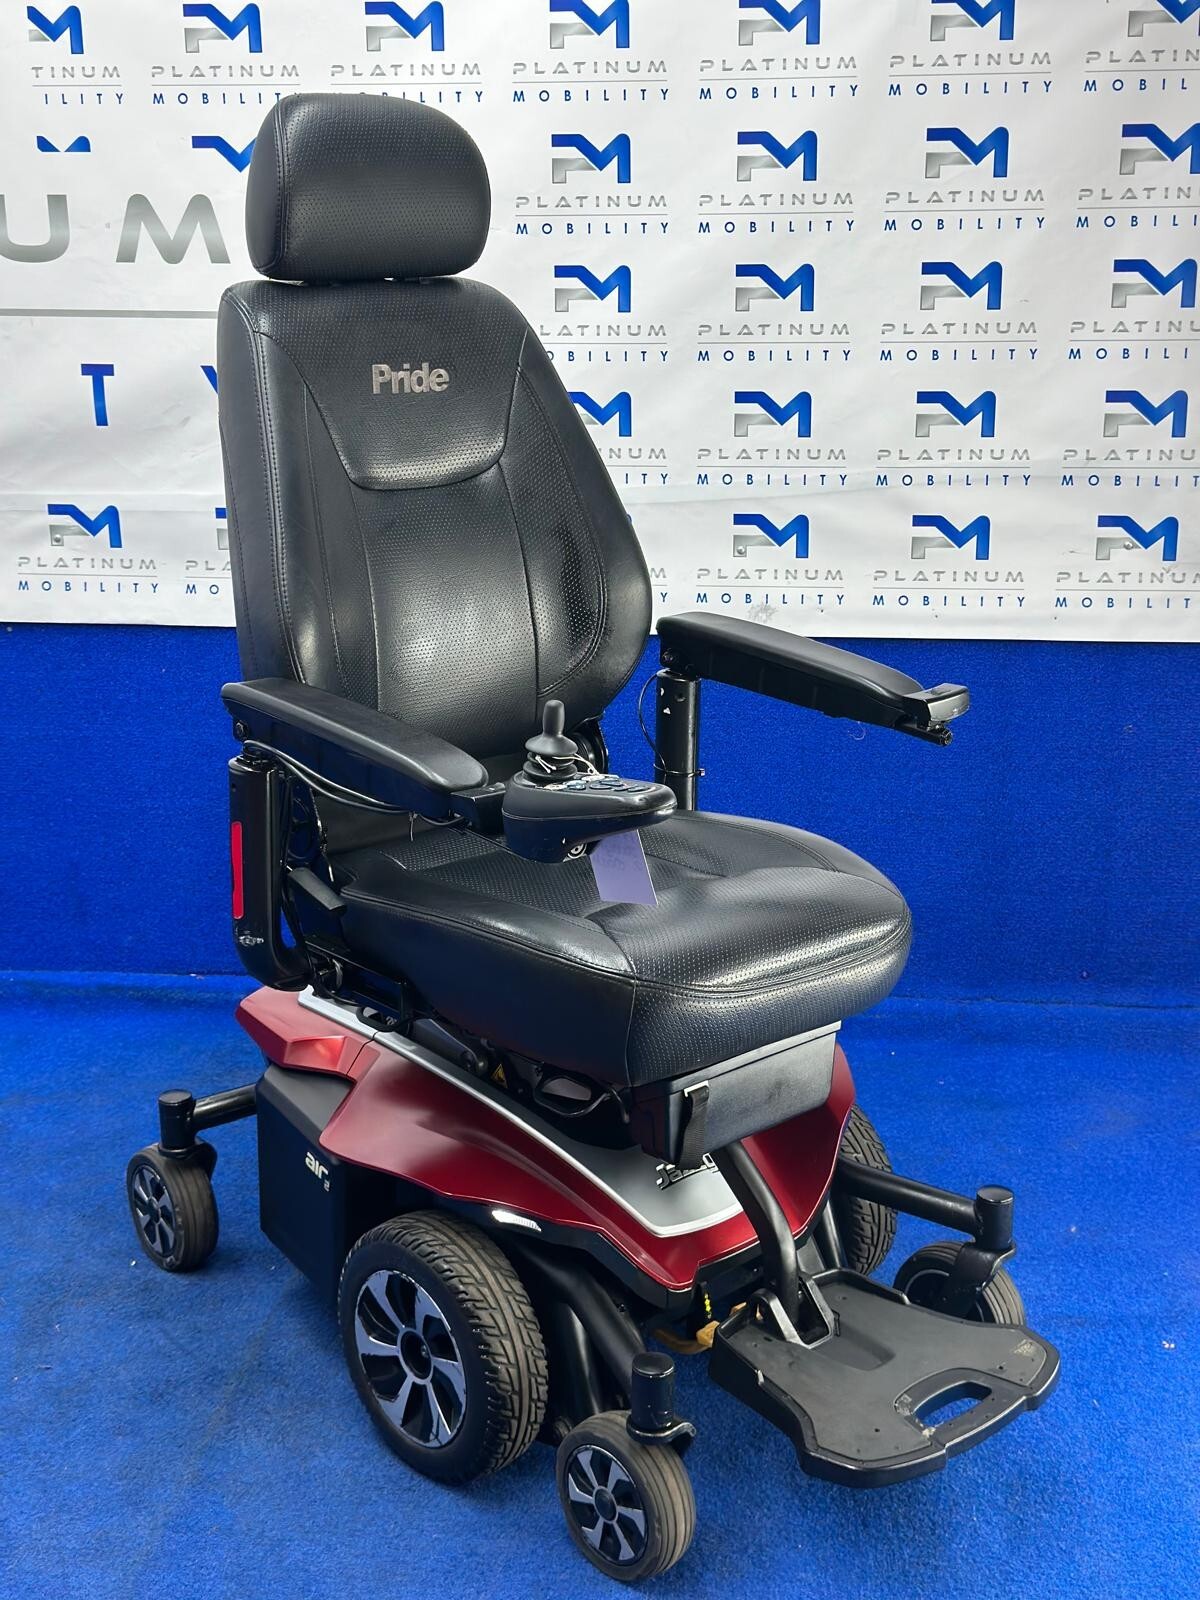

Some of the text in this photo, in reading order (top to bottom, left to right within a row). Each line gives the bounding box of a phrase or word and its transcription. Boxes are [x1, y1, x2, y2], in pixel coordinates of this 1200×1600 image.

[700, 56, 856, 72] PLATINUM
[890, 52, 1051, 68] PLATINUM
[152, 65, 299, 78] PLATINUM
[331, 63, 480, 76] PLATINUM
[513, 60, 667, 75] PLATINUM
[513, 88, 669, 102] MOBILITY
[699, 84, 858, 100] MOBILITY
[888, 81, 1052, 96] MOBILITY
[152, 92, 302, 105] MOBILIT
[516, 195, 667, 208] PLATINUM
[699, 193, 853, 206] PLATINUM
[886, 189, 1044, 204] PLATINUM
[516, 222, 668, 235] MOBILITY
[698, 220, 854, 233] MOBILITY
[884, 217, 1045, 231] MOBILITY
[698, 324, 849, 336] PLATINUM
[881, 322, 1036, 335] PLATINUM
[698, 350, 851, 361] MOBILITY
[880, 348, 1037, 361] MOBILITY
[372, 362, 450, 395] Pride
[698, 449, 846, 460] PLATINUM
[877, 449, 1030, 460] PLATINUM
[697, 474, 847, 486] MOBILITY
[876, 474, 1032, 486] MOBILITY
[18, 557, 156, 569] PLATINUM
[697, 568, 843, 580] PLATINUM
[874, 570, 1024, 582] PLATINUM
[18, 580, 158, 593] MOBILITY
[696, 593, 845, 606] MOBILITY
[873, 595, 1025, 607] MOBILITY
[305, 1151, 329, 1179] air
